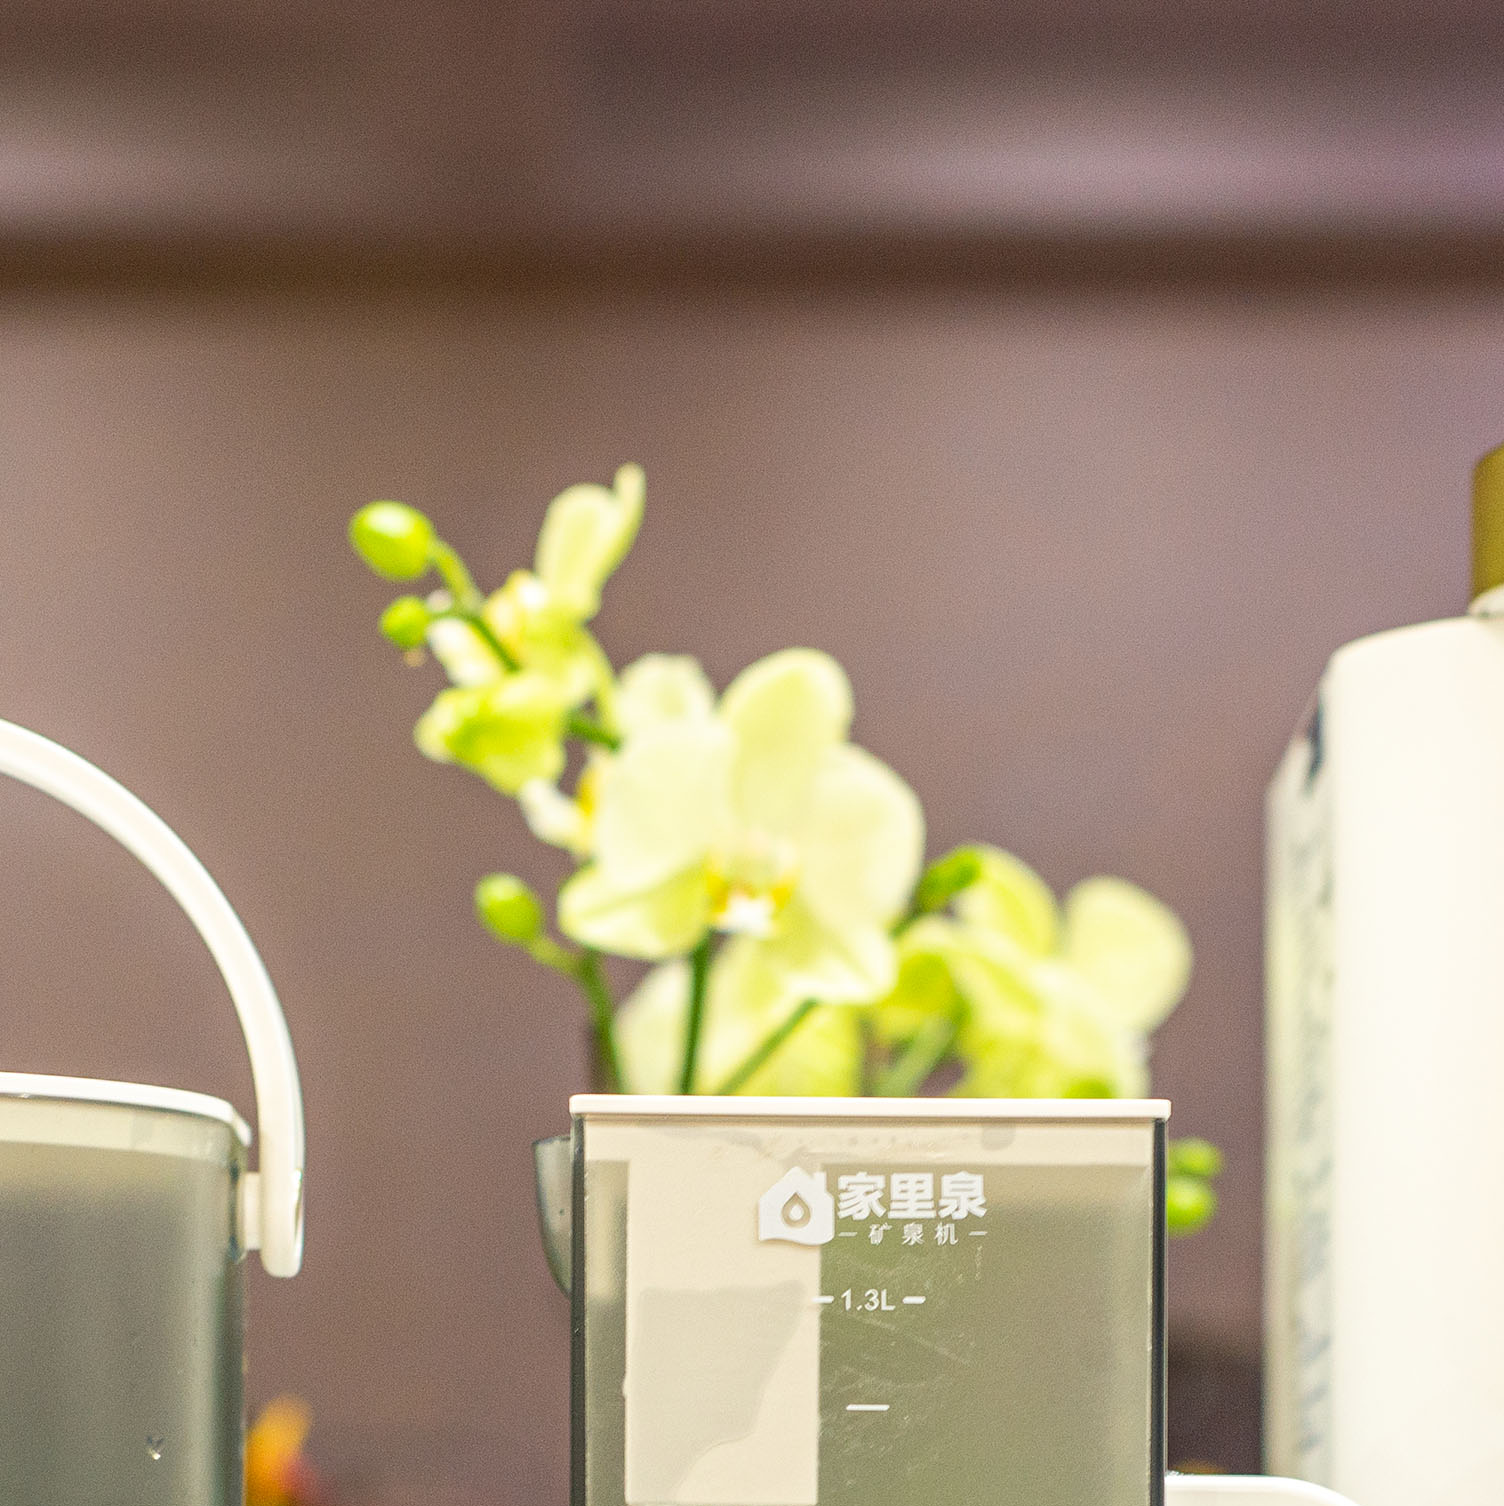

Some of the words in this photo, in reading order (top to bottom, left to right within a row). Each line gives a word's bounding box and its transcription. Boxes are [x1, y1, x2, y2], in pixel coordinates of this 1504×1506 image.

[837, 1171, 988, 1221] 家里泉
[869, 1223, 959, 1246] 矿泉机
[841, 1289, 896, 1311] 1.3L
